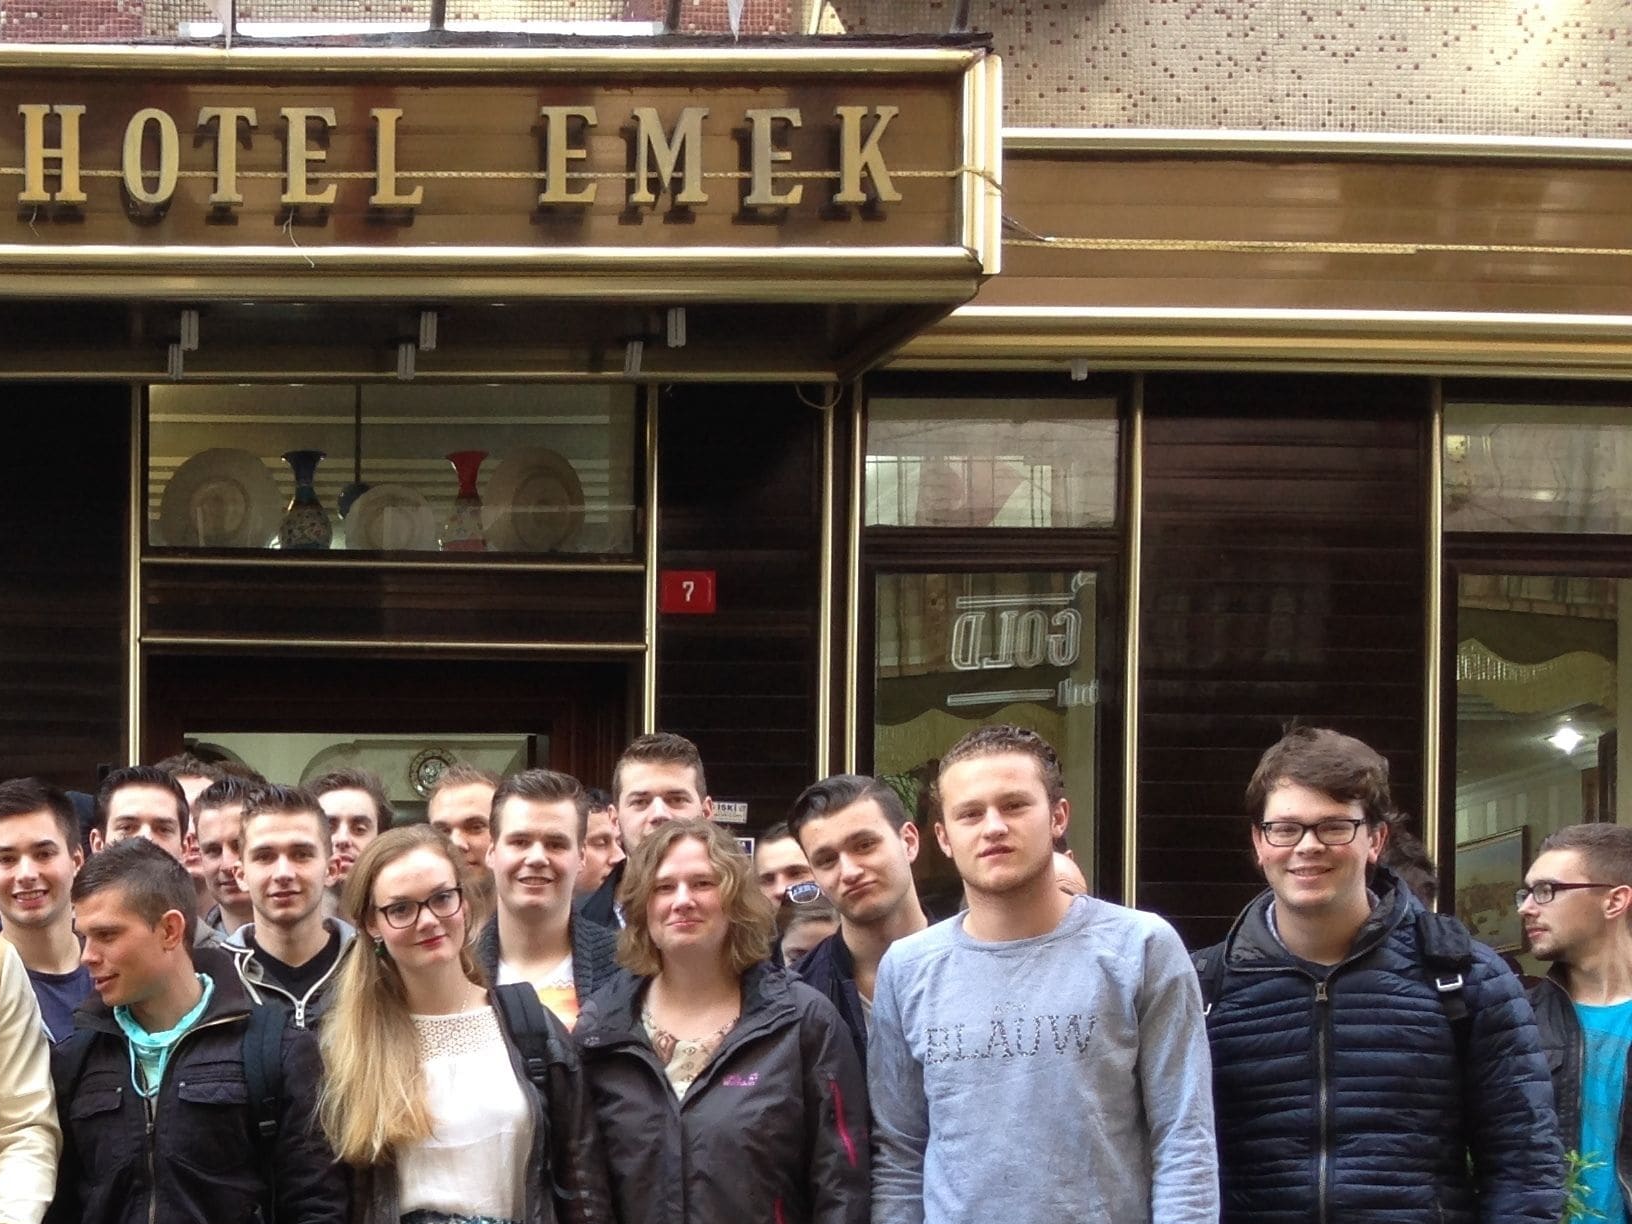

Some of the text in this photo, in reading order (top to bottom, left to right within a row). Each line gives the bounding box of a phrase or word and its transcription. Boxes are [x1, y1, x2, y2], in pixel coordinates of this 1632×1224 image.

[18, 104, 903, 210] HOTEL EMEK
[682, 581, 694, 602] 7
